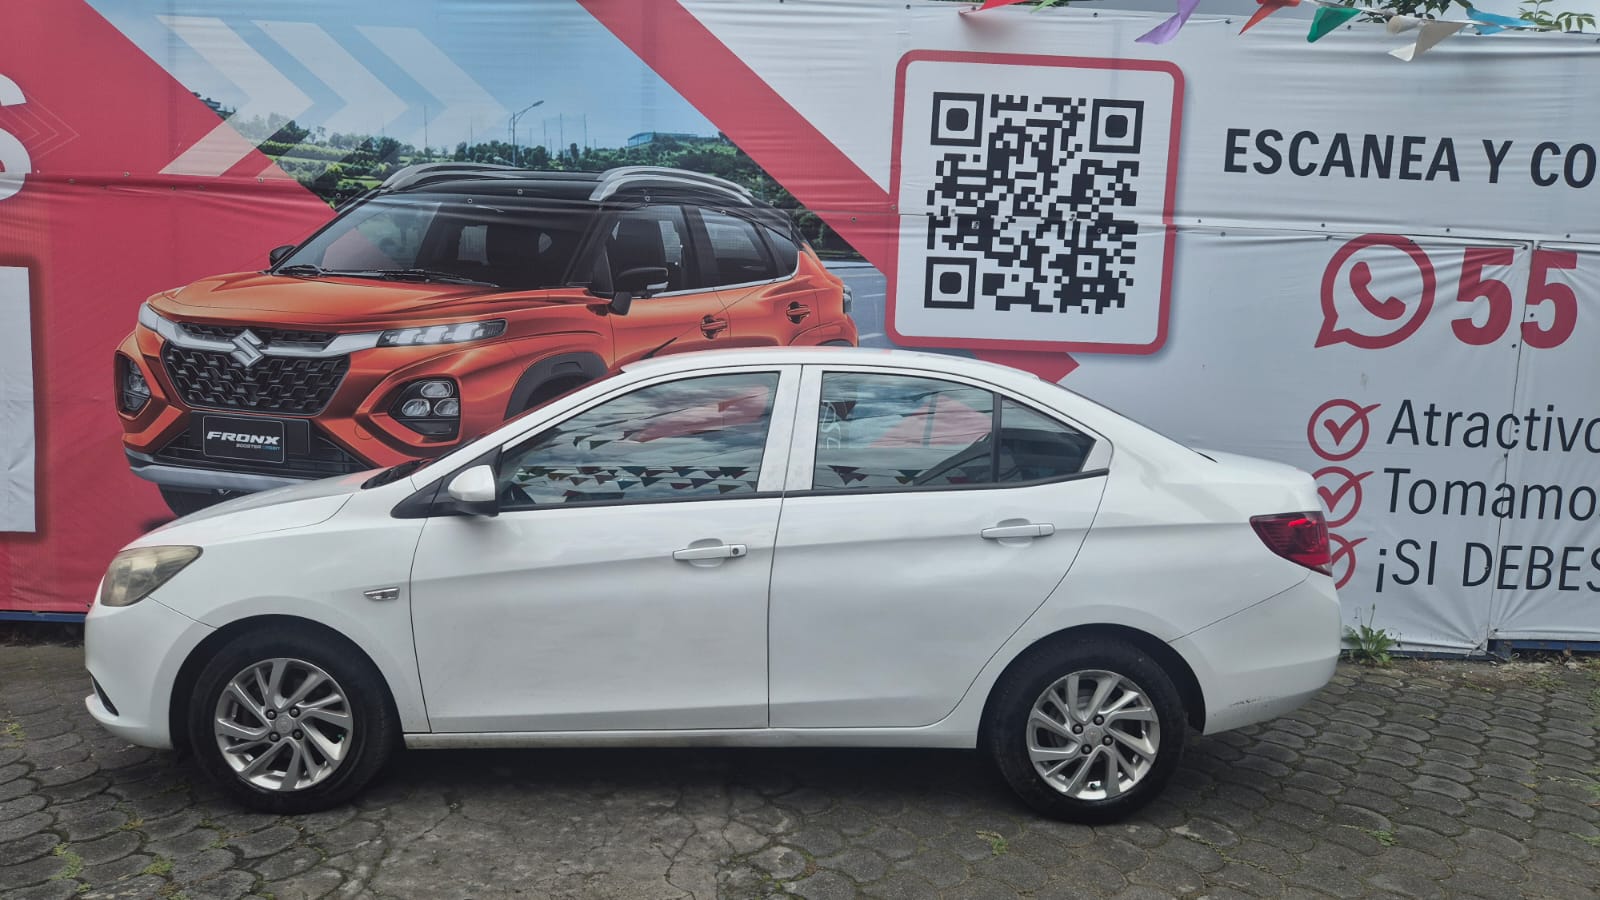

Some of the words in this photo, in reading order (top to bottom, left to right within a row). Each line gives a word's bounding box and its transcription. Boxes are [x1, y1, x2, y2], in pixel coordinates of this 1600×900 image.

[1224, 128, 1460, 182] ESCANEA
[1482, 139, 1513, 184] Y
[1530, 141, 1598, 189] CO
[1451, 247, 1578, 349] 55
[206, 431, 280, 445] FRONX
[1383, 467, 1600, 521] Tomamo
[1375, 538, 1438, 593] ¡SI
